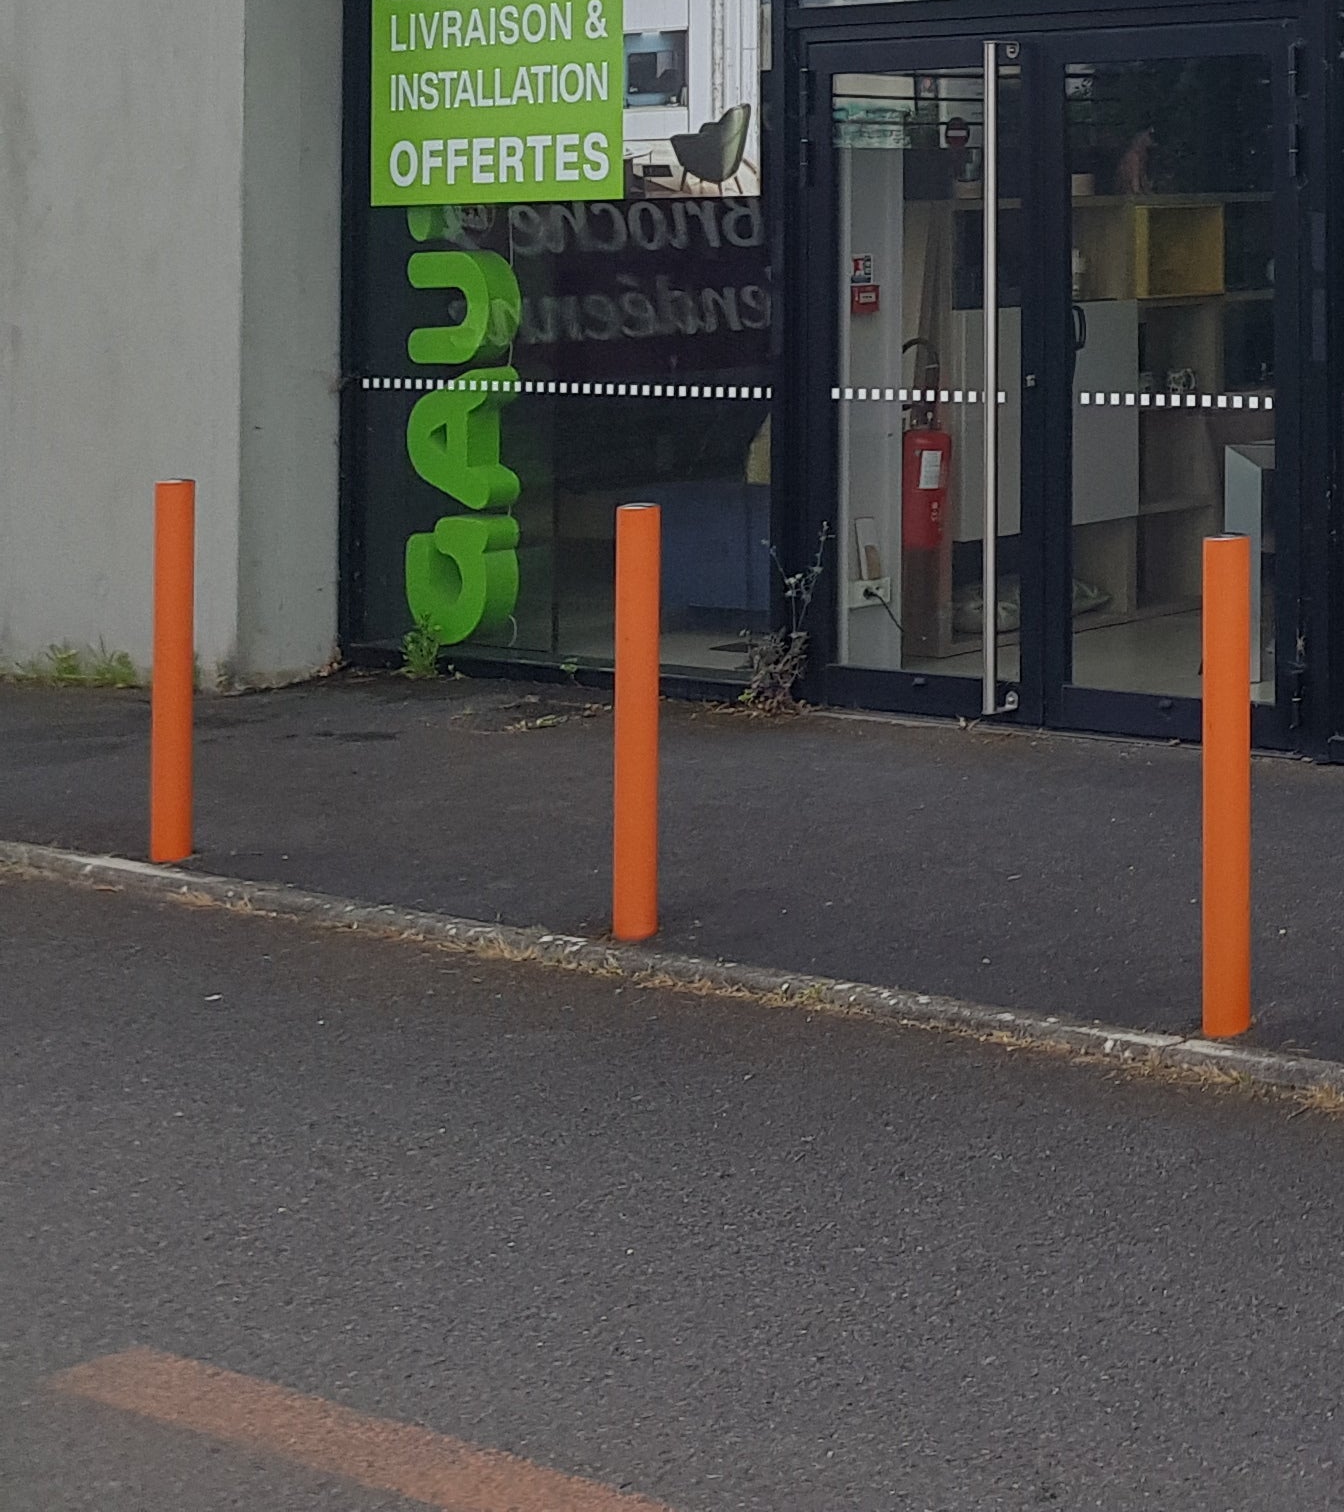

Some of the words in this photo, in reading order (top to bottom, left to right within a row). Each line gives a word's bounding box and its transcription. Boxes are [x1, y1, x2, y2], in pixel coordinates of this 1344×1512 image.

[390, 0, 573, 52] LIVRAISON
[390, 61, 609, 112] INSTALLATION
[389, 131, 611, 188] OFFERTES
